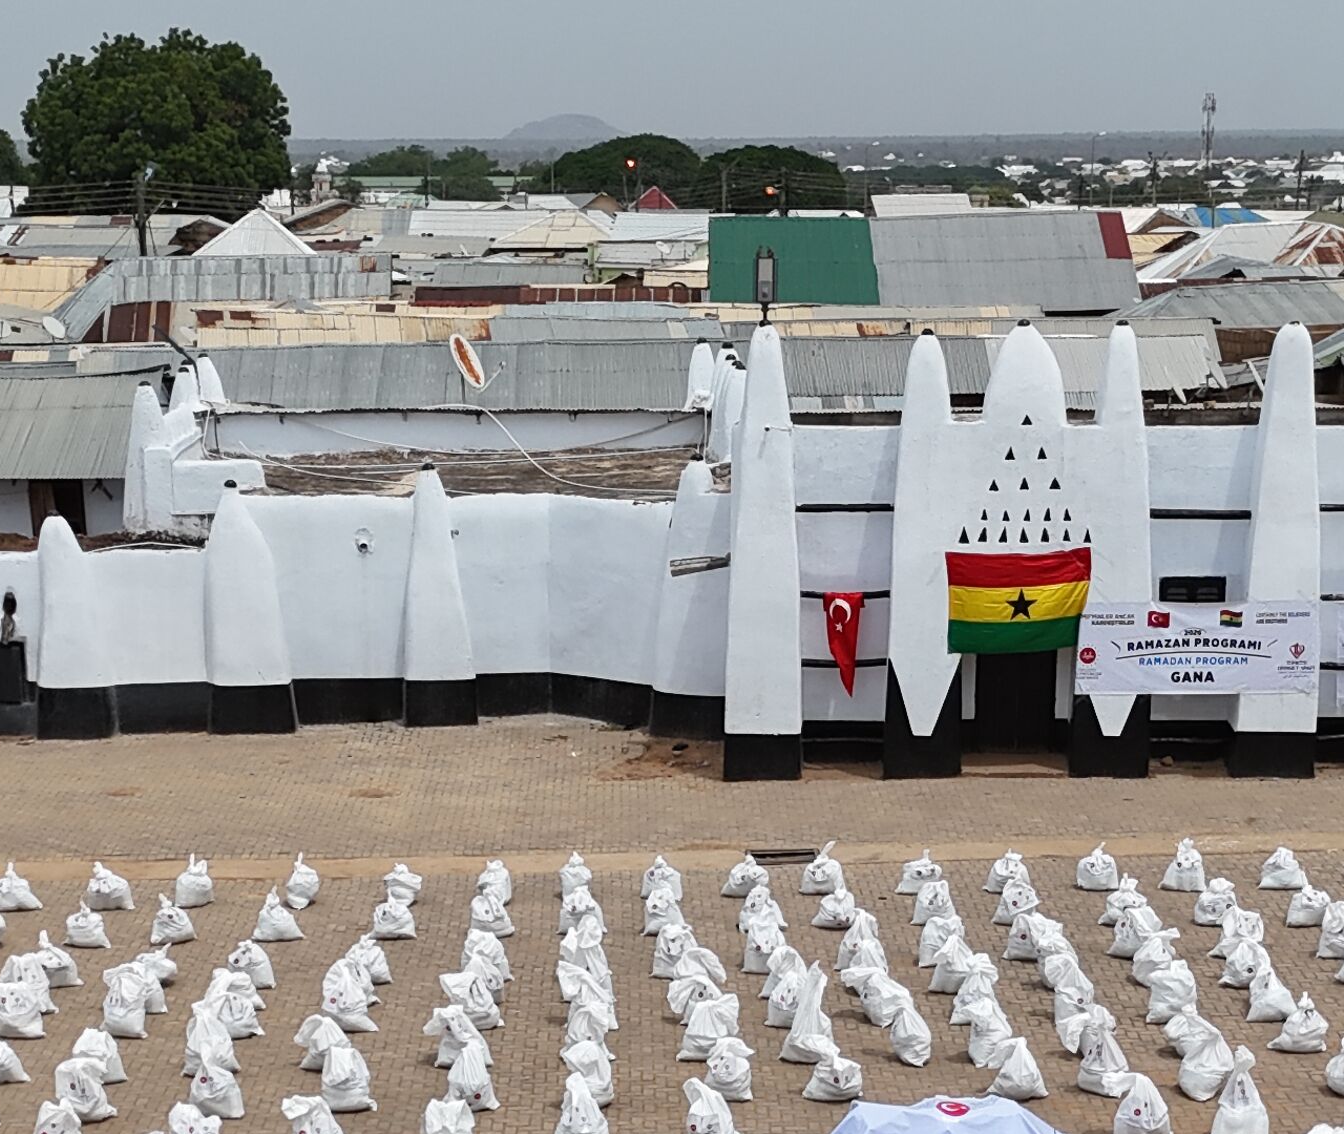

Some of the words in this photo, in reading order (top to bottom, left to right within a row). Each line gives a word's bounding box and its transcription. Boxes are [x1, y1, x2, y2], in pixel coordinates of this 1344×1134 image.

[1127, 637, 1190, 651] RAMAZAN
[1194, 637, 1262, 650] PROGRAMI
[1138, 657, 1192, 666] RAMADAN
[1196, 656, 1249, 666] PROGRAM
[1170, 671, 1215, 683] GANA
